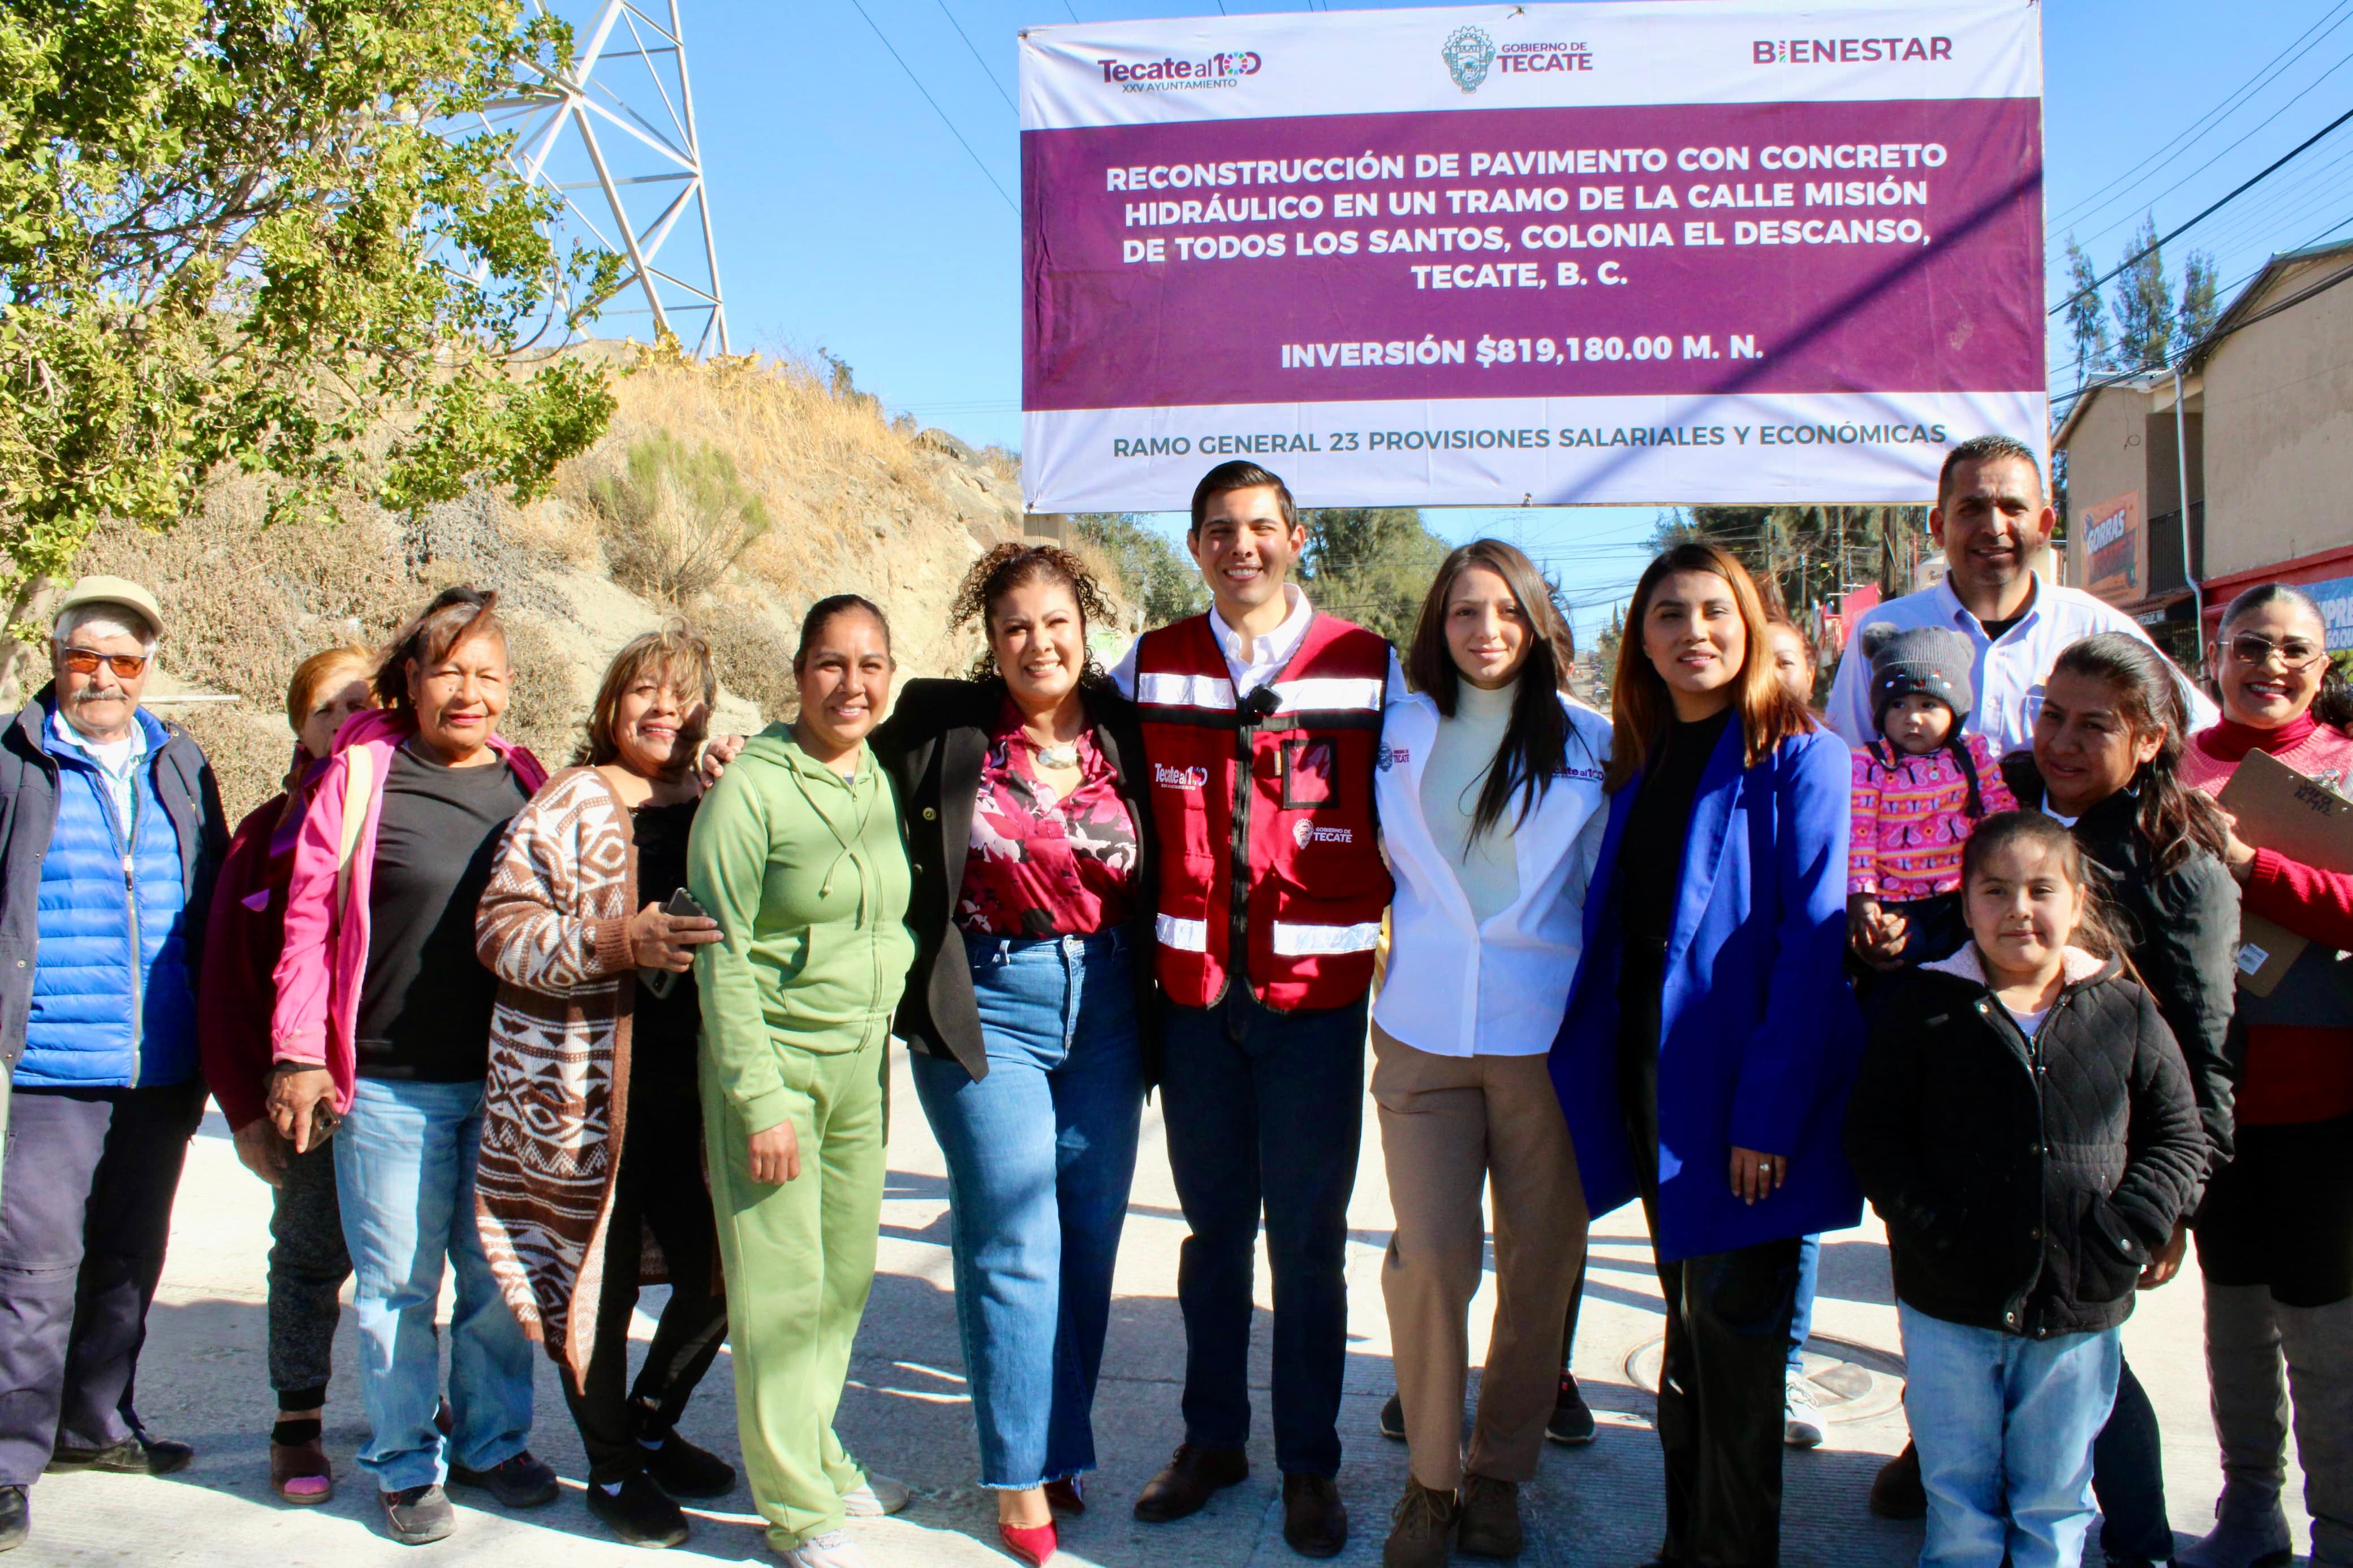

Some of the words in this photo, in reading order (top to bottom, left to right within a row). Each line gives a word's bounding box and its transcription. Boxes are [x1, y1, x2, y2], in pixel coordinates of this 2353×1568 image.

[1497, 53, 1593, 72] TECATE
[1502, 43, 1567, 53] GOBIERNO
[1571, 42, 1587, 51] DE
[1753, 37, 1951, 63] BIENESTAR
[1098, 58, 1191, 85] Tecate
[1195, 59, 1212, 77] al
[1214, 52, 1261, 76] 100
[1122, 84, 1144, 92] XXV
[1147, 79, 1236, 92] AYUNTAMIENTO
[1107, 150, 1403, 191] RECONSTRUCCIÓN
[1416, 154, 1459, 178] DE
[1471, 149, 1667, 176] PAVIMENTO
[1678, 147, 1749, 171] CON
[1760, 144, 1947, 170] CONCRETO
[1126, 193, 1323, 226] HIDRÁULICO
[1334, 193, 1377, 217] EN
[1389, 191, 1435, 215] UN
[1446, 188, 1568, 213] TRAMO
[1580, 187, 1624, 210] DE
[1636, 185, 1678, 209] LA
[1688, 183, 1794, 208] CALLE
[1805, 175, 1927, 206] MISIÓN
[1124, 239, 1165, 262] DE
[1175, 234, 1286, 260] TODOS
[1296, 231, 1358, 256] LOS
[1369, 227, 1511, 253] SANTOS,
[1522, 223, 1674, 249] COLONIA
[1685, 222, 1724, 245] EL
[1735, 219, 1930, 245] DESCANSO,
[1411, 263, 1546, 289] TECATE,
[1558, 262, 1587, 286] B.
[1598, 261, 1627, 285] C.
[1282, 334, 1464, 368] INVERSIÓN
[1476, 335, 1672, 368] $819,180.00
[1683, 335, 1719, 359] M.
[1730, 335, 1762, 358] N.
[1114, 438, 1190, 457] RAMO
[1199, 434, 1321, 454] GENERAL
[1330, 433, 1359, 451] 23
[1369, 430, 1549, 450] PROVISIONES
[1559, 426, 1724, 448] SALARIALES
[1733, 427, 1750, 444] Y
[1760, 421, 1946, 446] ECONÓMICAS
[2088, 509, 2125, 555] GORRAS
[1155, 763, 1179, 784] Tecate
[1179, 770, 1188, 784] al
[1313, 832, 1352, 843] TECATE
